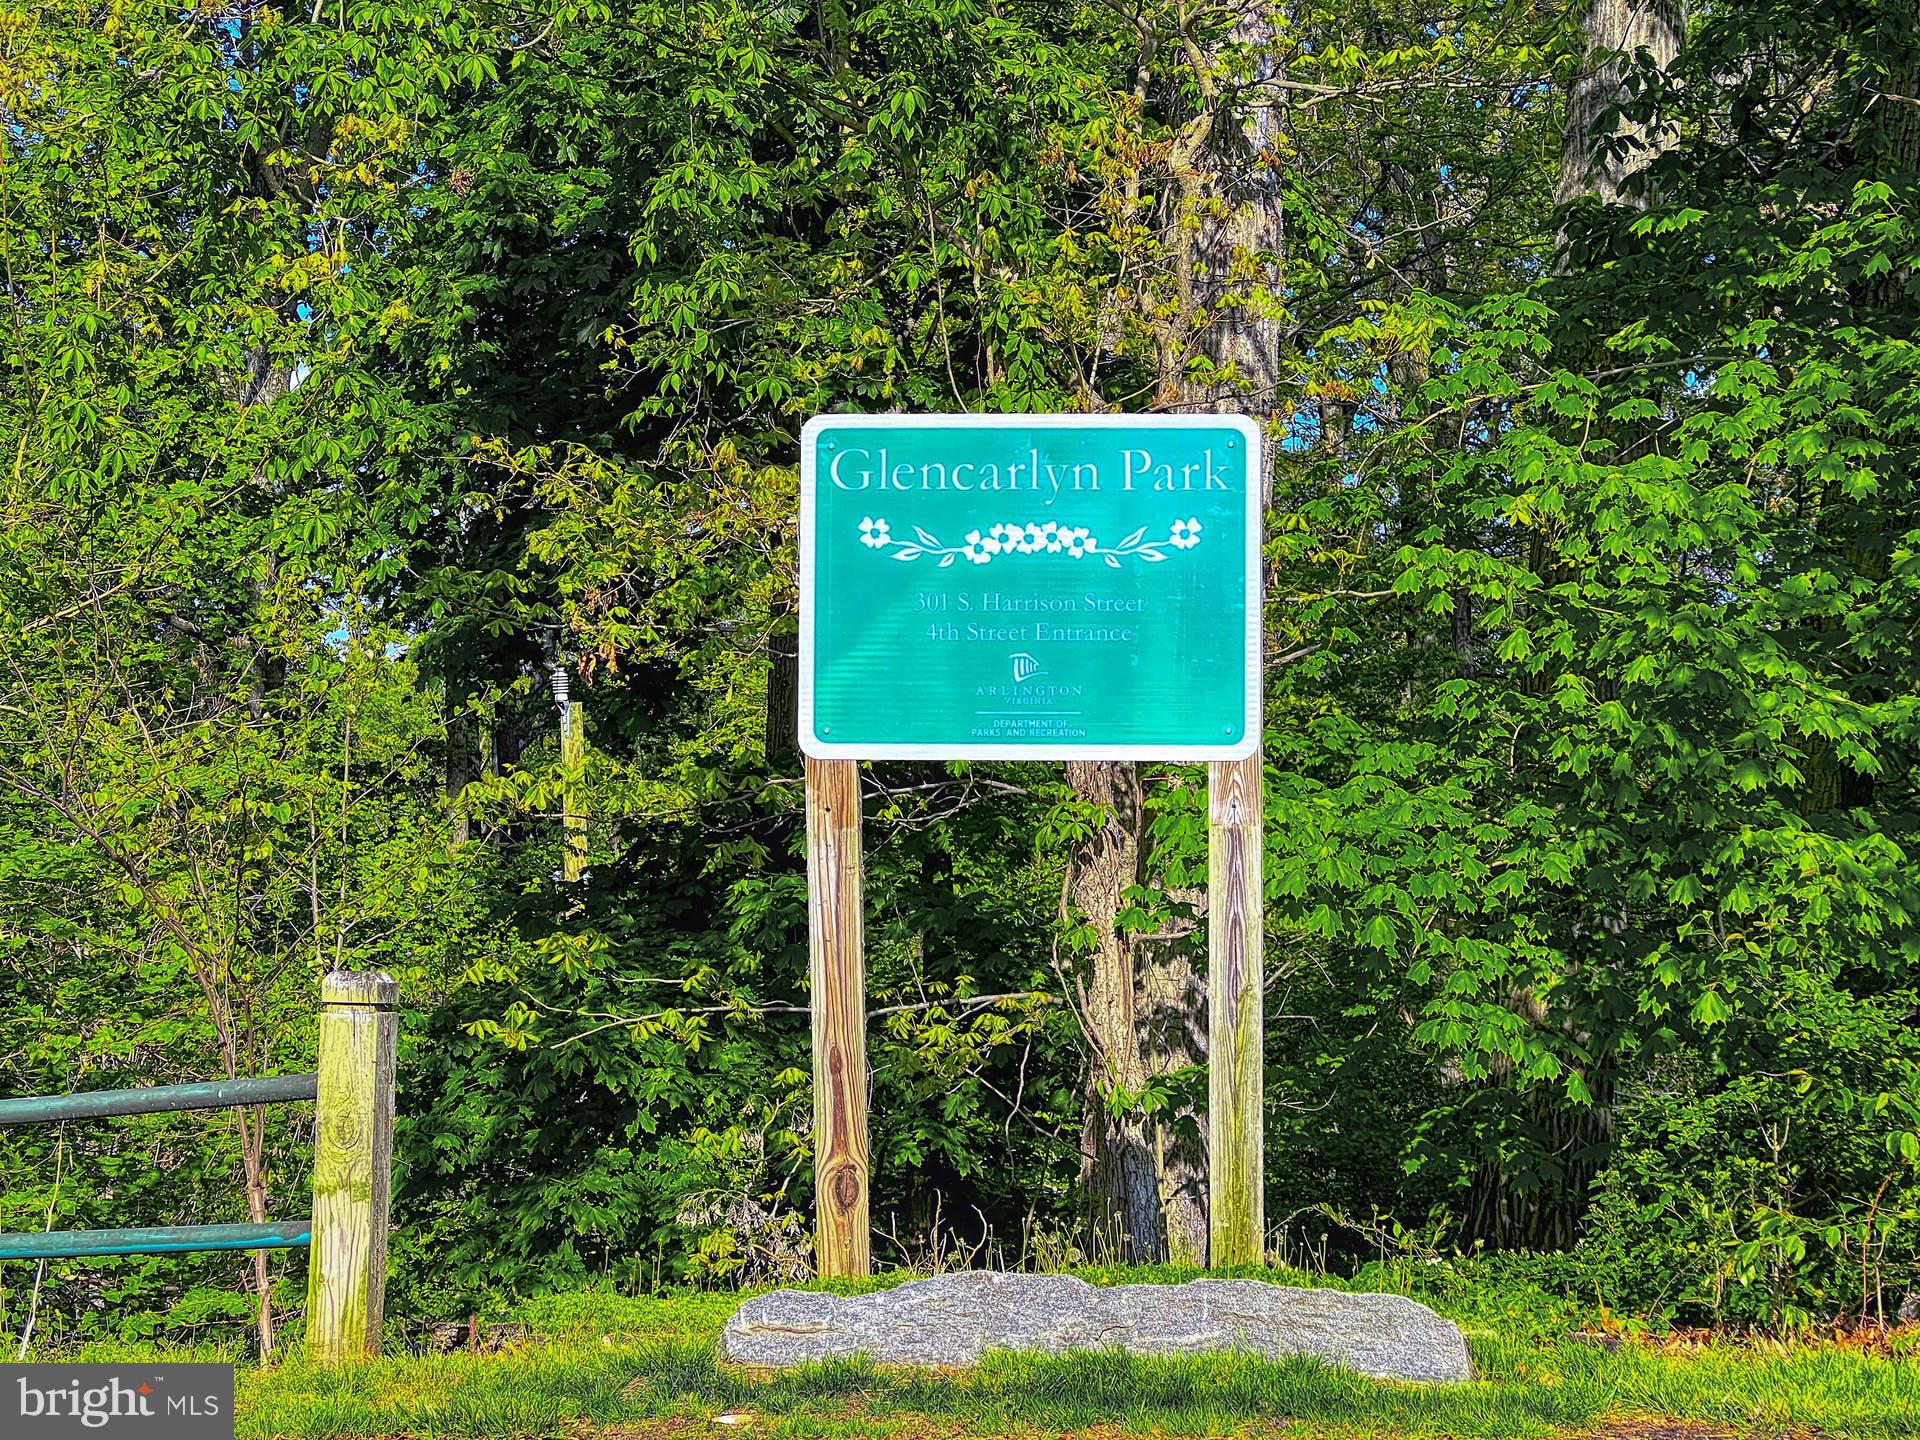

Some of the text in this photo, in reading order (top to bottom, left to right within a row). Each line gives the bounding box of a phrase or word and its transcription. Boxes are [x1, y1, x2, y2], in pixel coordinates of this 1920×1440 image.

[829, 448, 1231, 504] Glencarlyn Park
[914, 592, 1145, 612] 301 S. Harrison Street
[927, 622, 1133, 641] 4th Street Entrance
[976, 685, 1083, 696] ARLINGTON
[1004, 696, 1053, 705] VIRGINIA
[993, 719, 1068, 728] DEPARTMENT OF
[971, 728, 1086, 737] PARKS AND RECREATION
